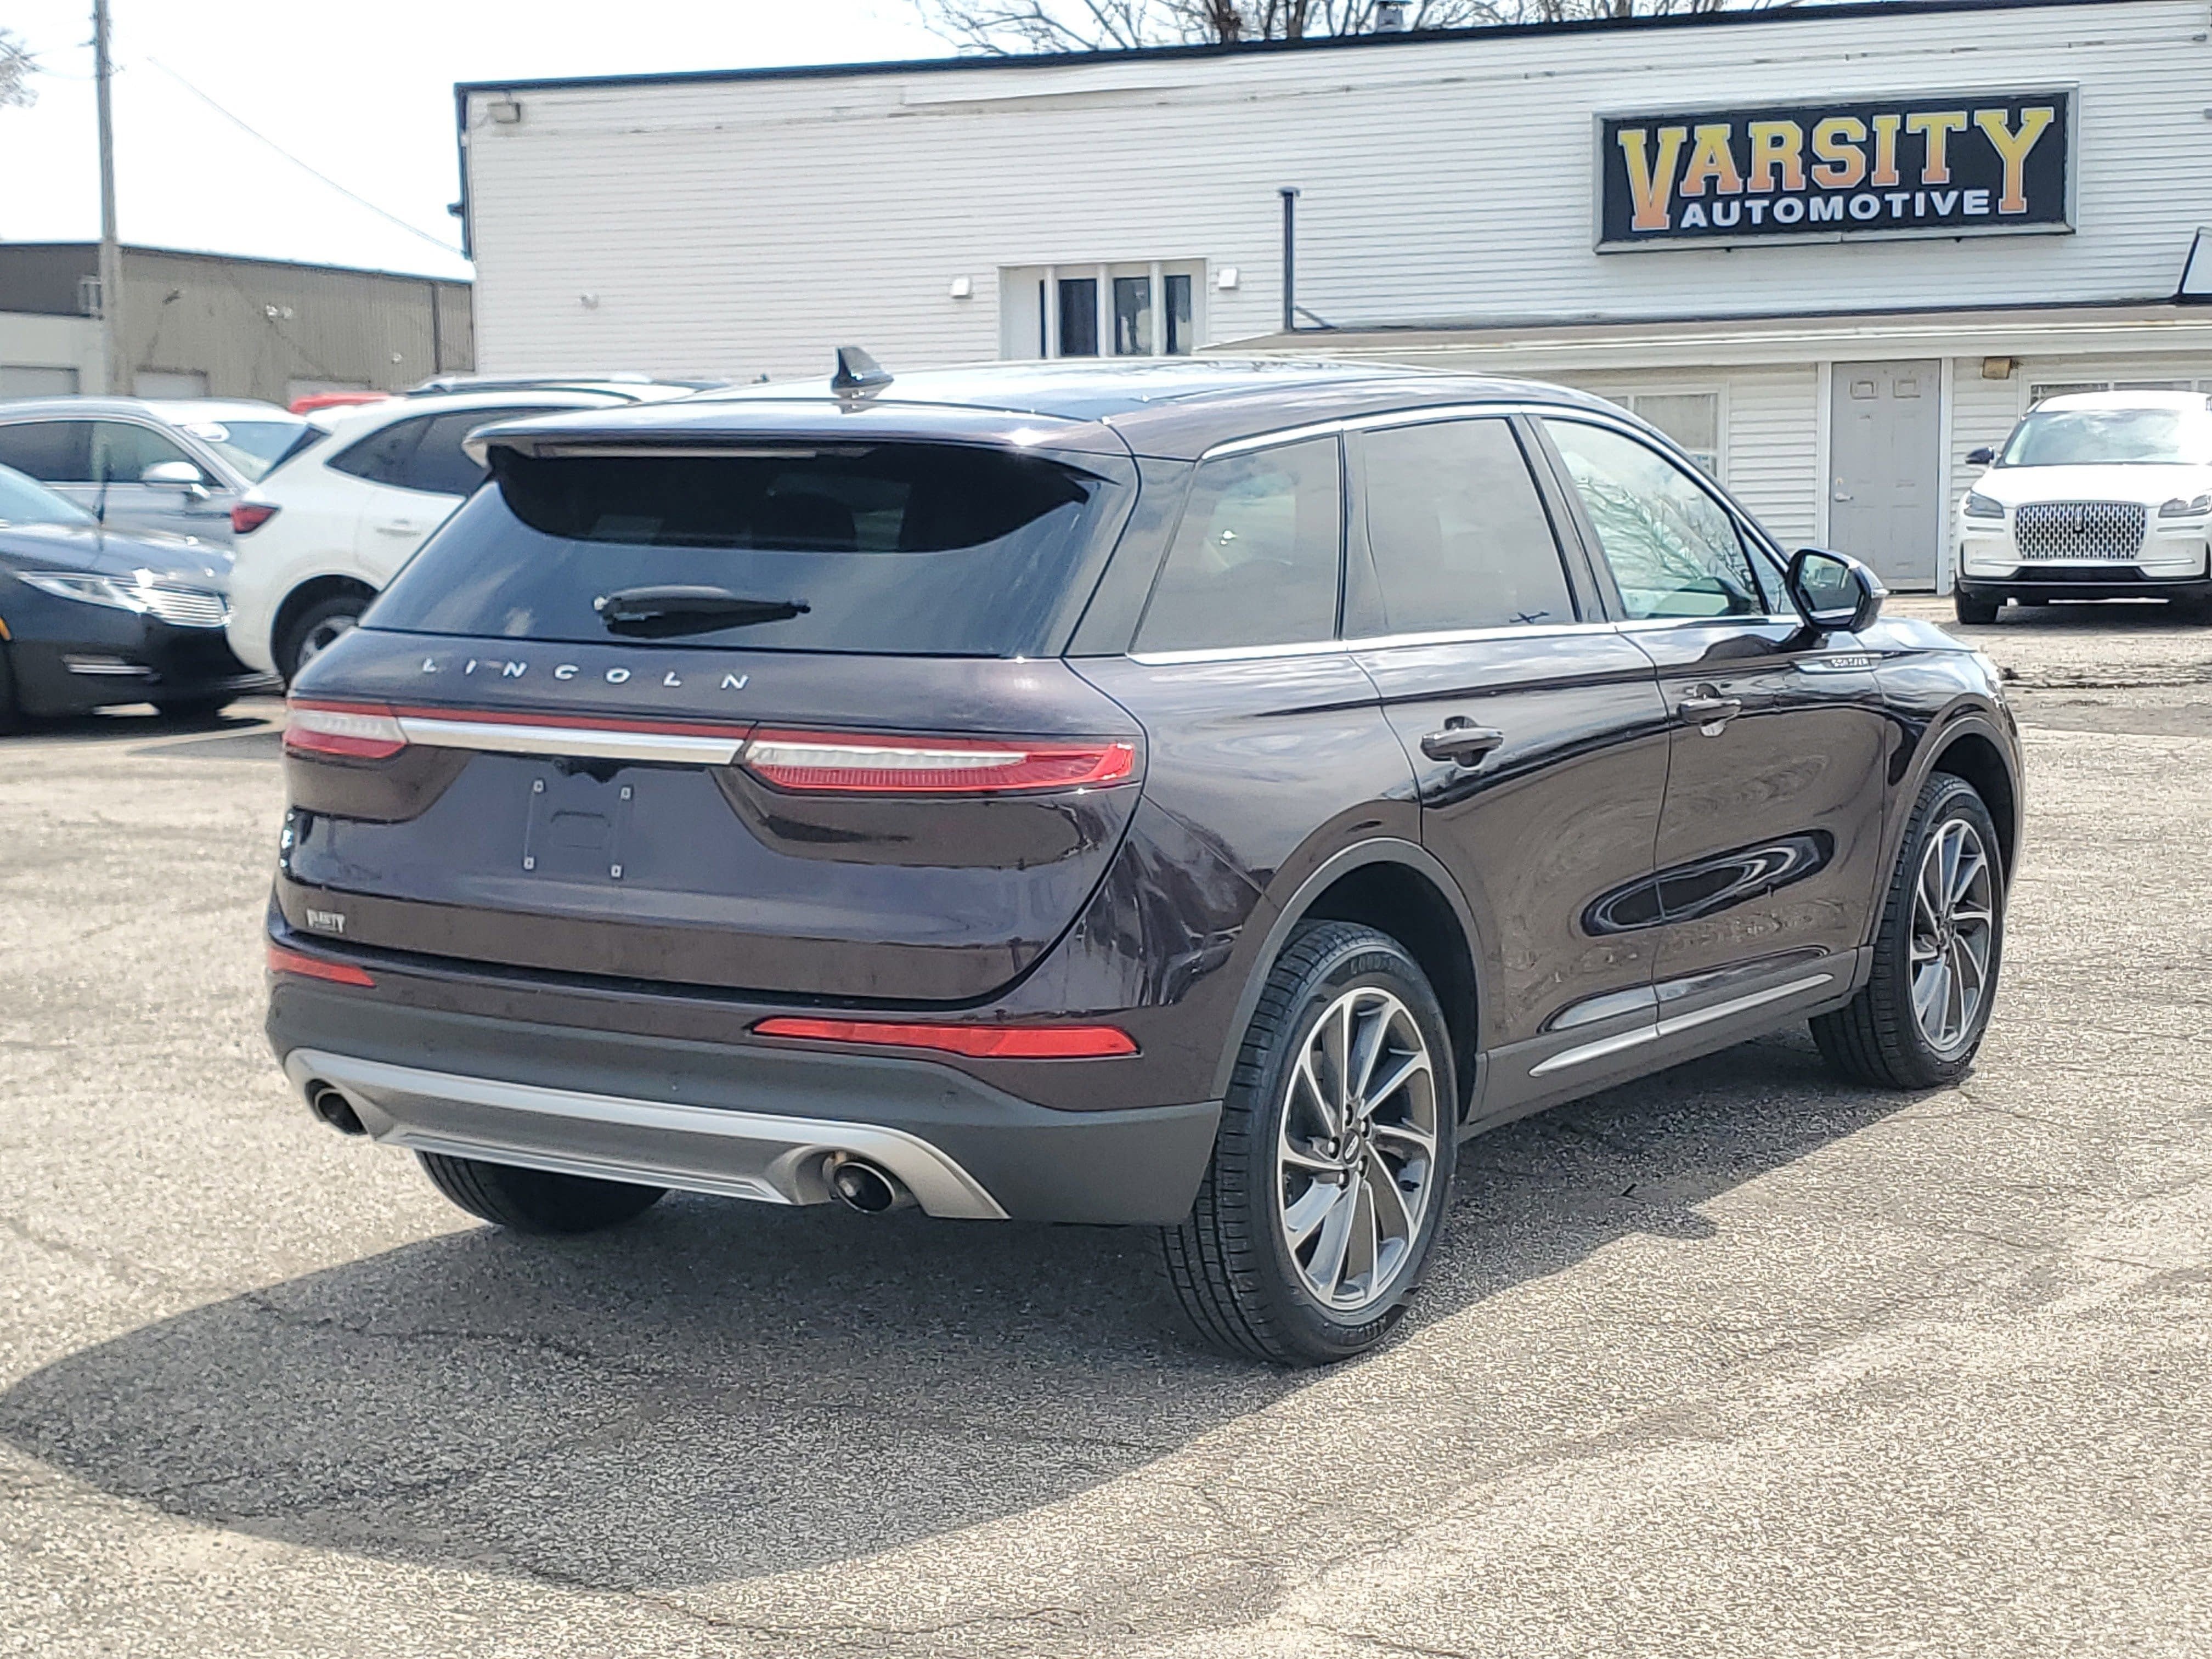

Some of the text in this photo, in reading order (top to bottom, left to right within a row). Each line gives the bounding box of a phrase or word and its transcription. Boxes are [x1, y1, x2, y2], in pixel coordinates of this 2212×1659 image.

[1618, 107, 2055, 232] VARSITY
[1680, 189, 1990, 228] AUTOMOTIVE
[422, 658, 749, 691] LINCOLN
